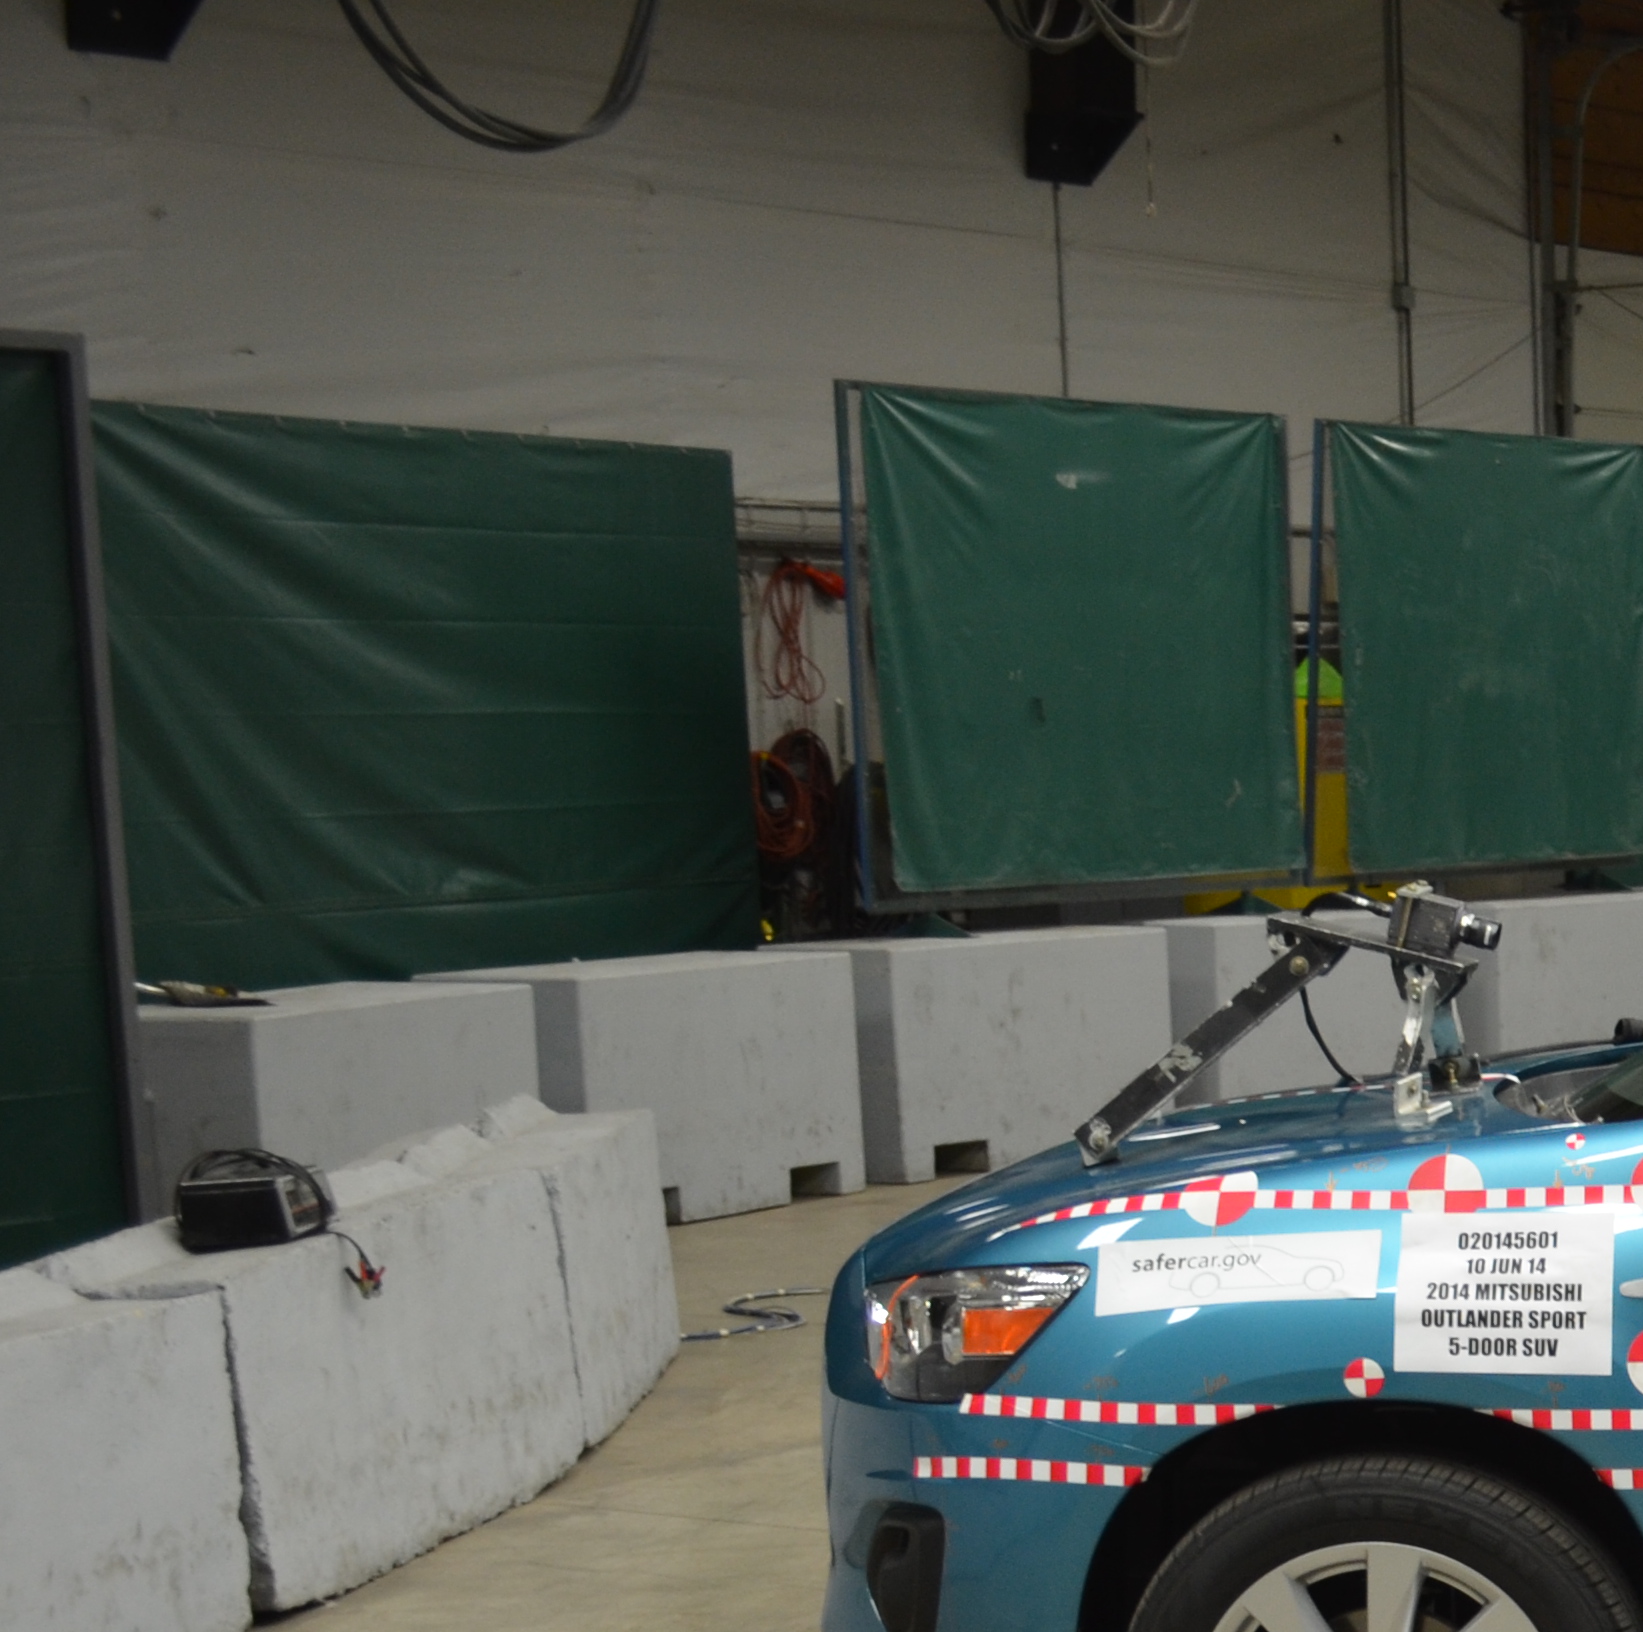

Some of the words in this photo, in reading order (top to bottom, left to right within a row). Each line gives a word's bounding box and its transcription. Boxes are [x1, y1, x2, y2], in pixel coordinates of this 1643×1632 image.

[1458, 1231, 1558, 1250] 020145601
[1132, 1253, 1261, 1272] safercar.gov
[1467, 1258, 1486, 1274] 10
[1490, 1258, 1522, 1274] JUN
[1528, 1258, 1546, 1274] 14
[1427, 1282, 1470, 1300] 2014
[1475, 1283, 1583, 1302] MITSUBISHI
[1421, 1309, 1523, 1328] OUTLANDER
[1528, 1310, 1587, 1329] SPORT
[1449, 1337, 1518, 1356] 5-DOOR
[1522, 1338, 1559, 1357] SUV
